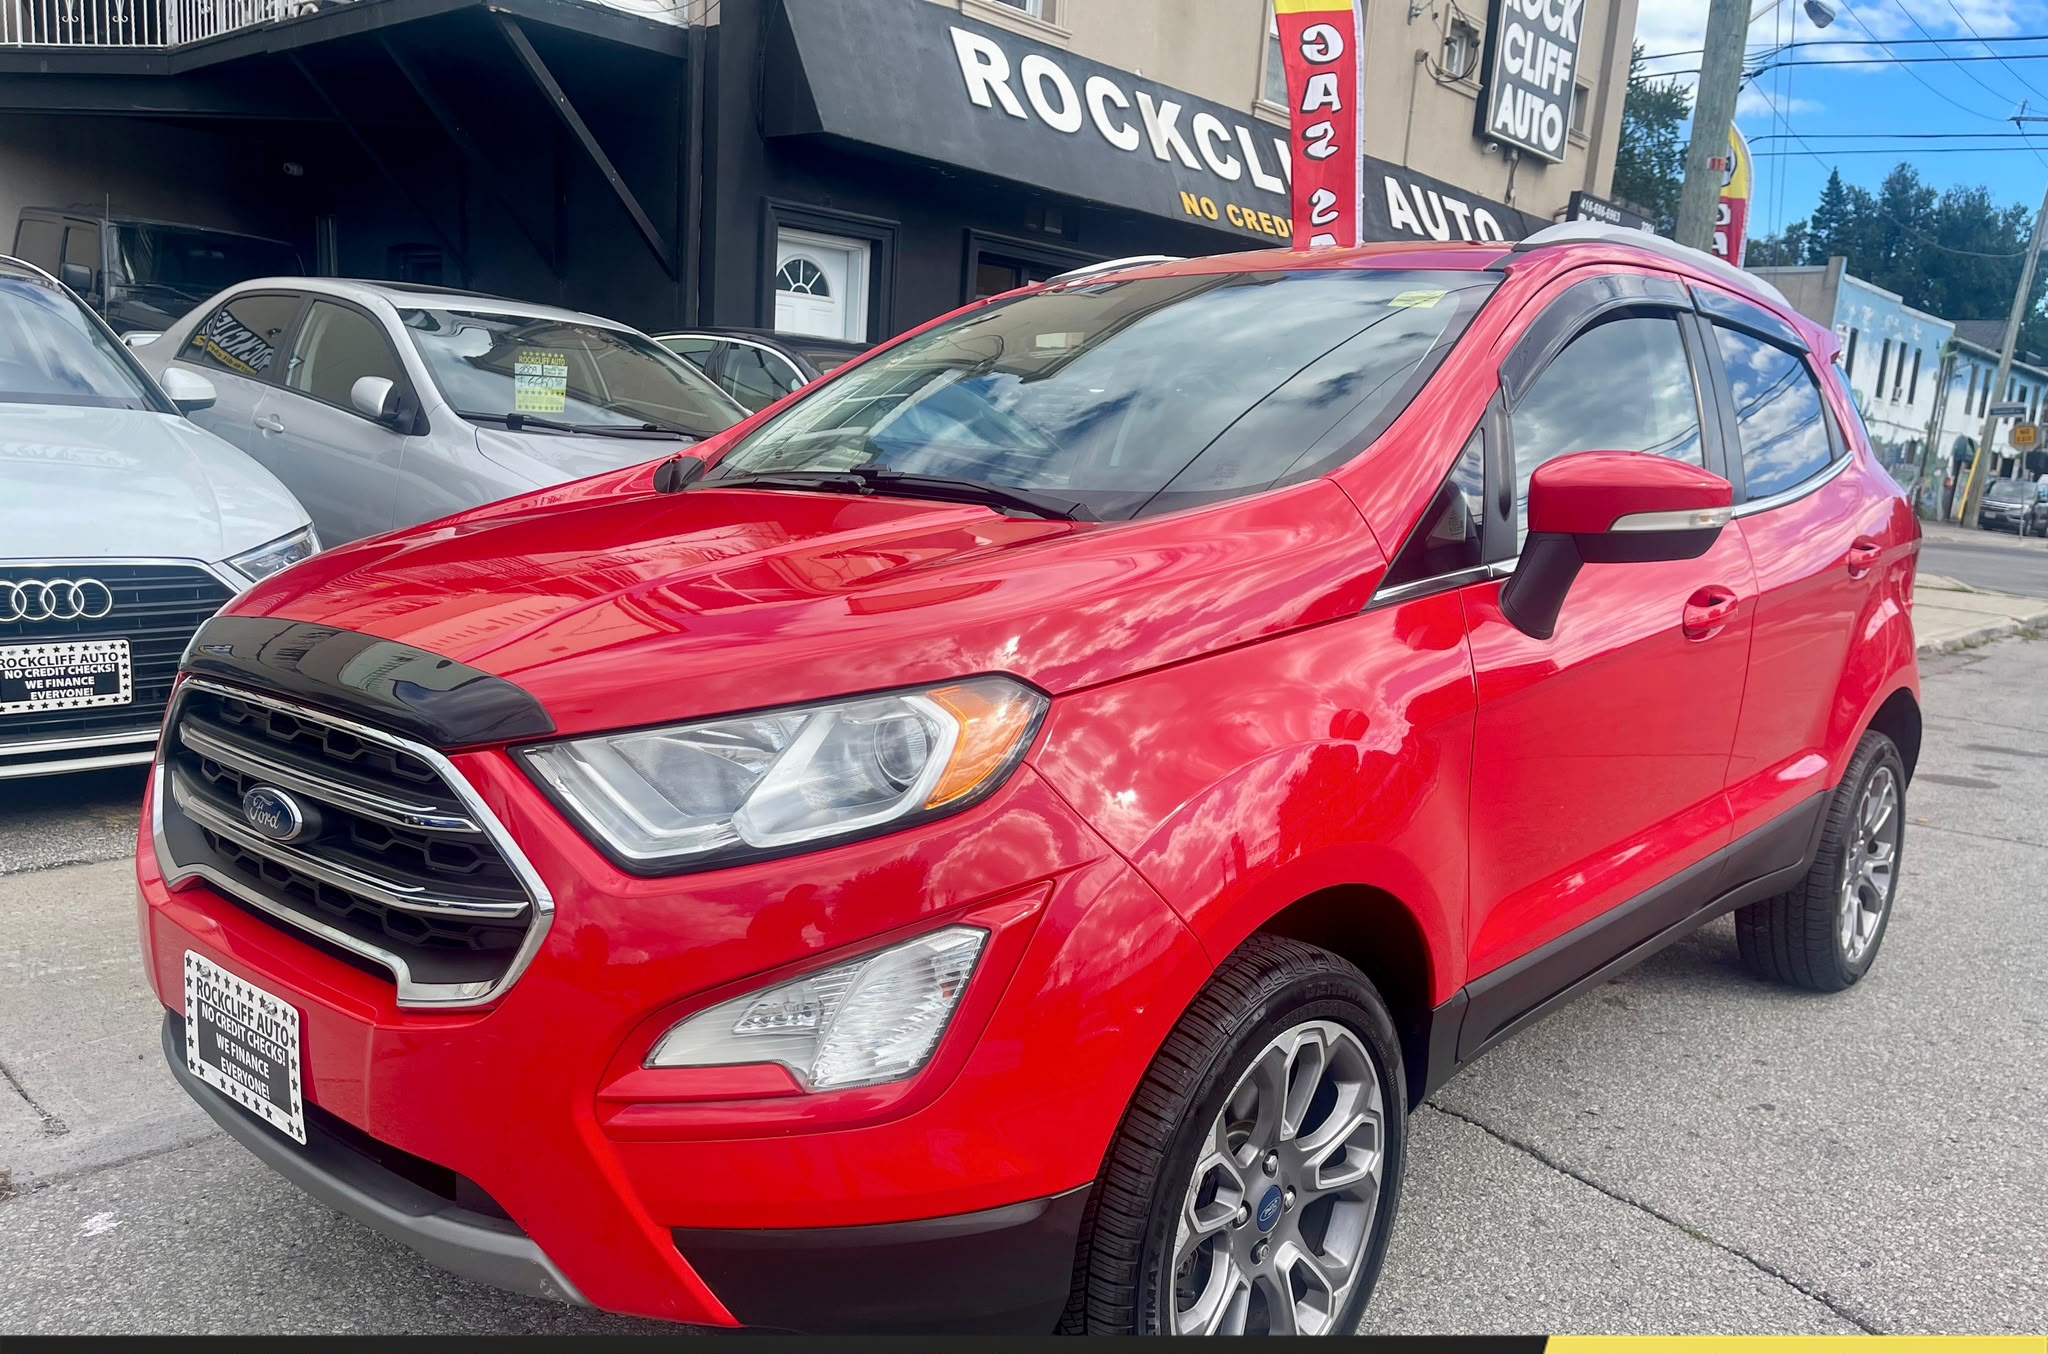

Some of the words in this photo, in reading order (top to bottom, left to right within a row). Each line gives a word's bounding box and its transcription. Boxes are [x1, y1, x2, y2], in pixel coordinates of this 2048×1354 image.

[1503, 22, 1573, 96] CLIFF
[949, 25, 1292, 196] ROCKCLI
[1383, 174, 1505, 242] AUTO
[1494, 82, 1564, 152] AUTO
[1179, 190, 1220, 222] NO
[518, 355, 550, 366] ROCKCLIFF
[551, 357, 566, 367] AUTO
[0, 654, 76, 669] ROCKCLIFF
[79, 651, 119, 664] AUTO
[4, 669, 23, 680] NO
[24, 666, 66, 678] CREDIT
[67, 663, 116, 676] CHECKS!
[24, 680, 44, 690] WE
[45, 676, 95, 688] FINANCE
[30, 687, 94, 700] EVERYONE!
[249, 794, 281, 829] Ford
[196, 976, 254, 1027] ROCKCLIFF
[256, 1012, 289, 1047] AUTO
[201, 1002, 215, 1023] NO
[215, 1012, 246, 1043] CREDIT
[247, 1030, 286, 1067] CHECKS!
[215, 1032, 230, 1054] WE
[230, 1041, 270, 1079] FINANCE
[220, 1056, 271, 1101] EVERYONE!
